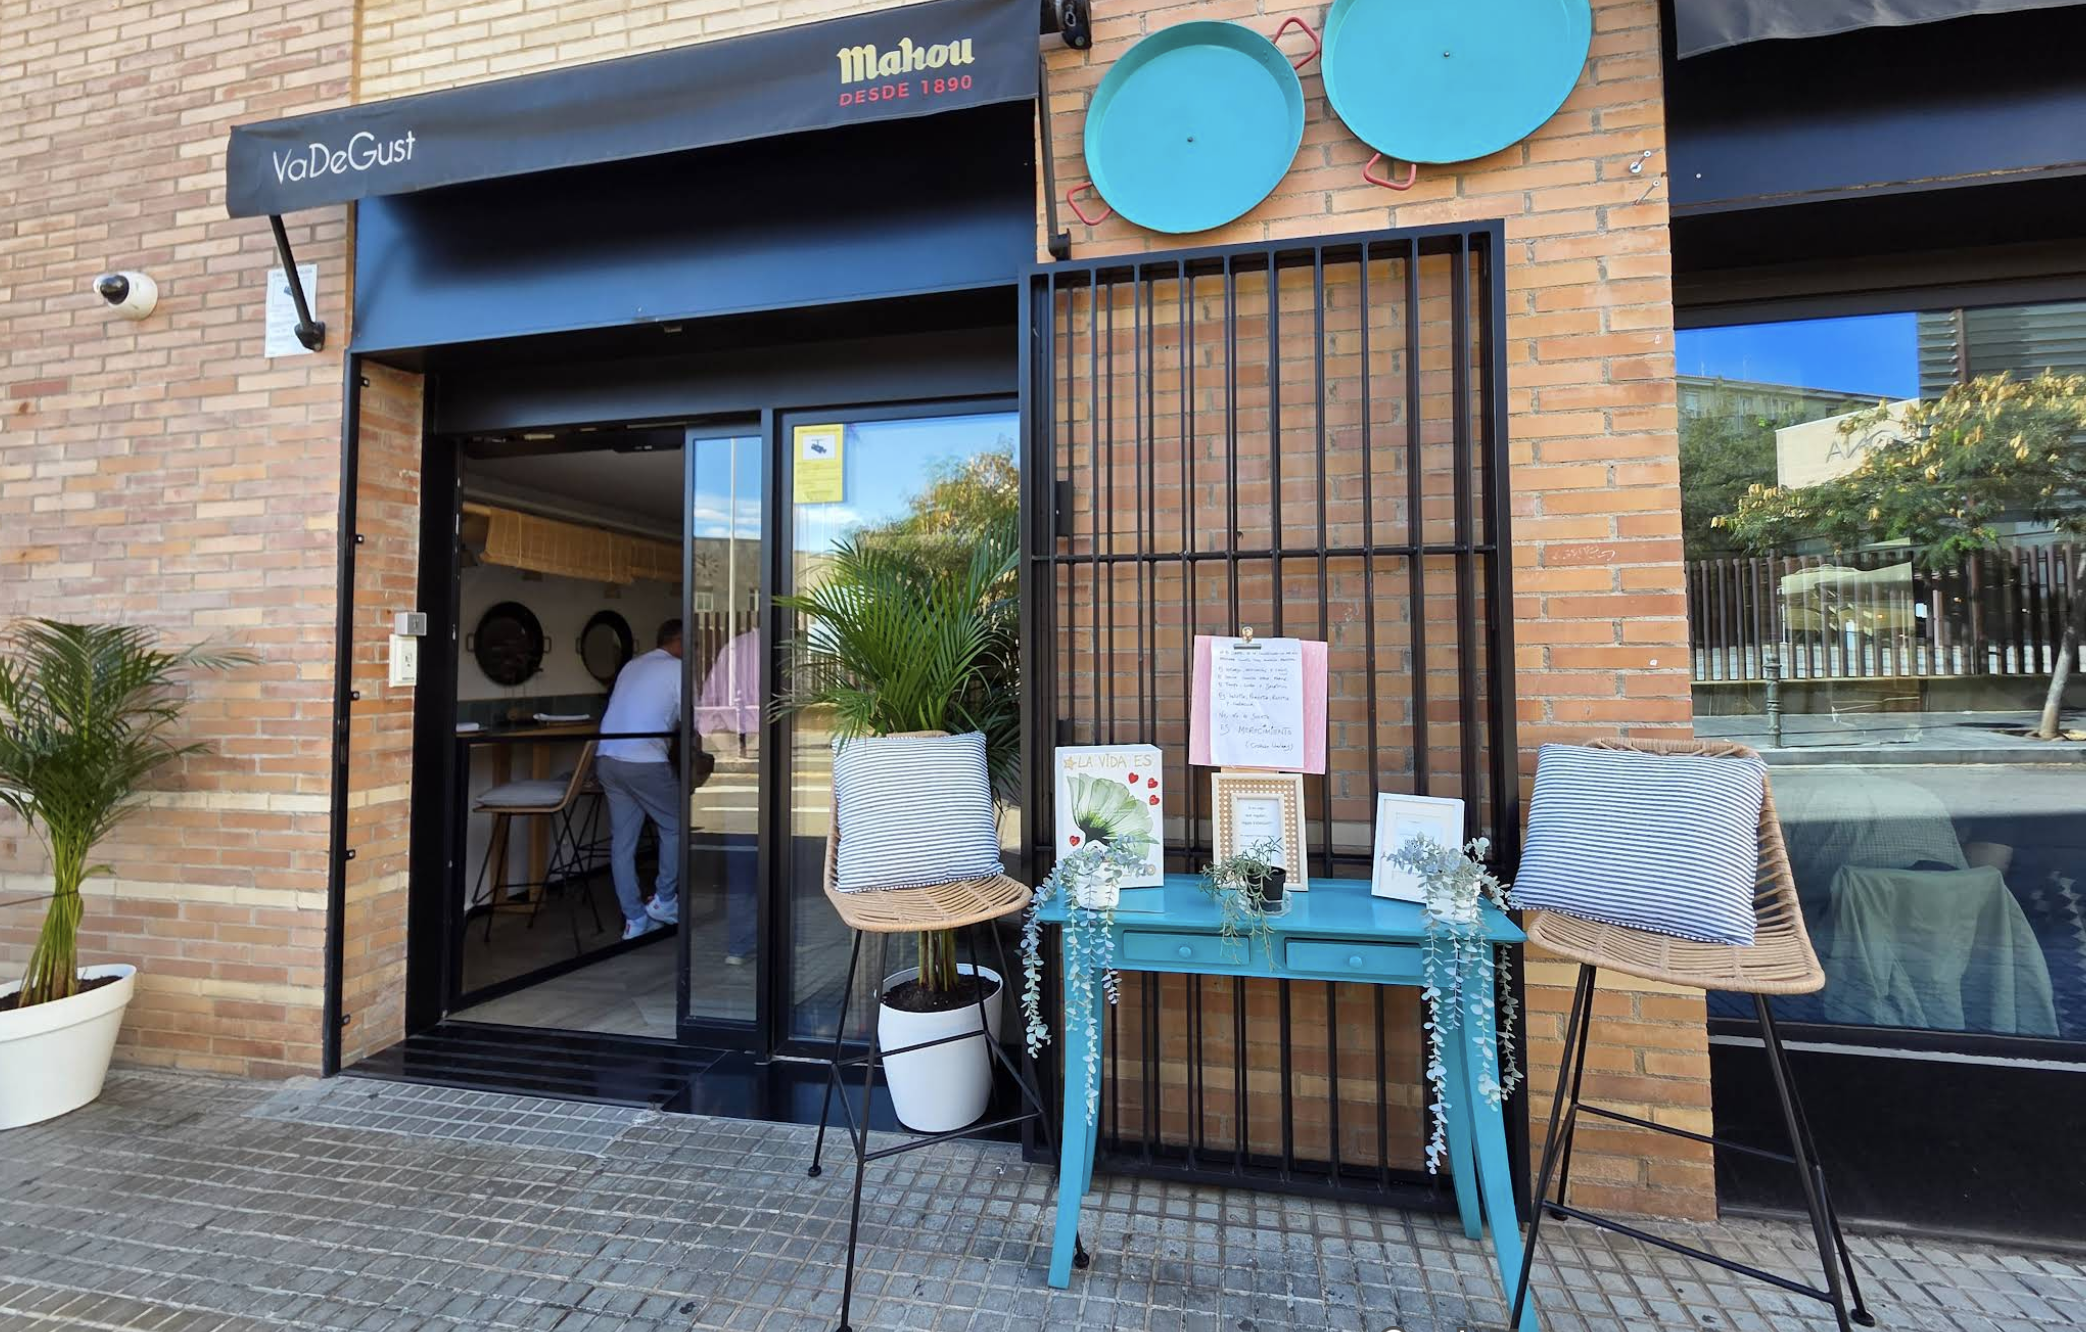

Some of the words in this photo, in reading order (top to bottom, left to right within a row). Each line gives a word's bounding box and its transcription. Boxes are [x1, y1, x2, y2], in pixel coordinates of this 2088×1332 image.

[836, 37, 975, 84] Mahou
[839, 82, 910, 107] DESDE
[920, 75, 972, 94] 1890
[272, 130, 416, 184] VaDeGust
[1078, 755, 1093, 768] LA
[1098, 753, 1127, 768] VIDA
[1133, 754, 1153, 767] ES
